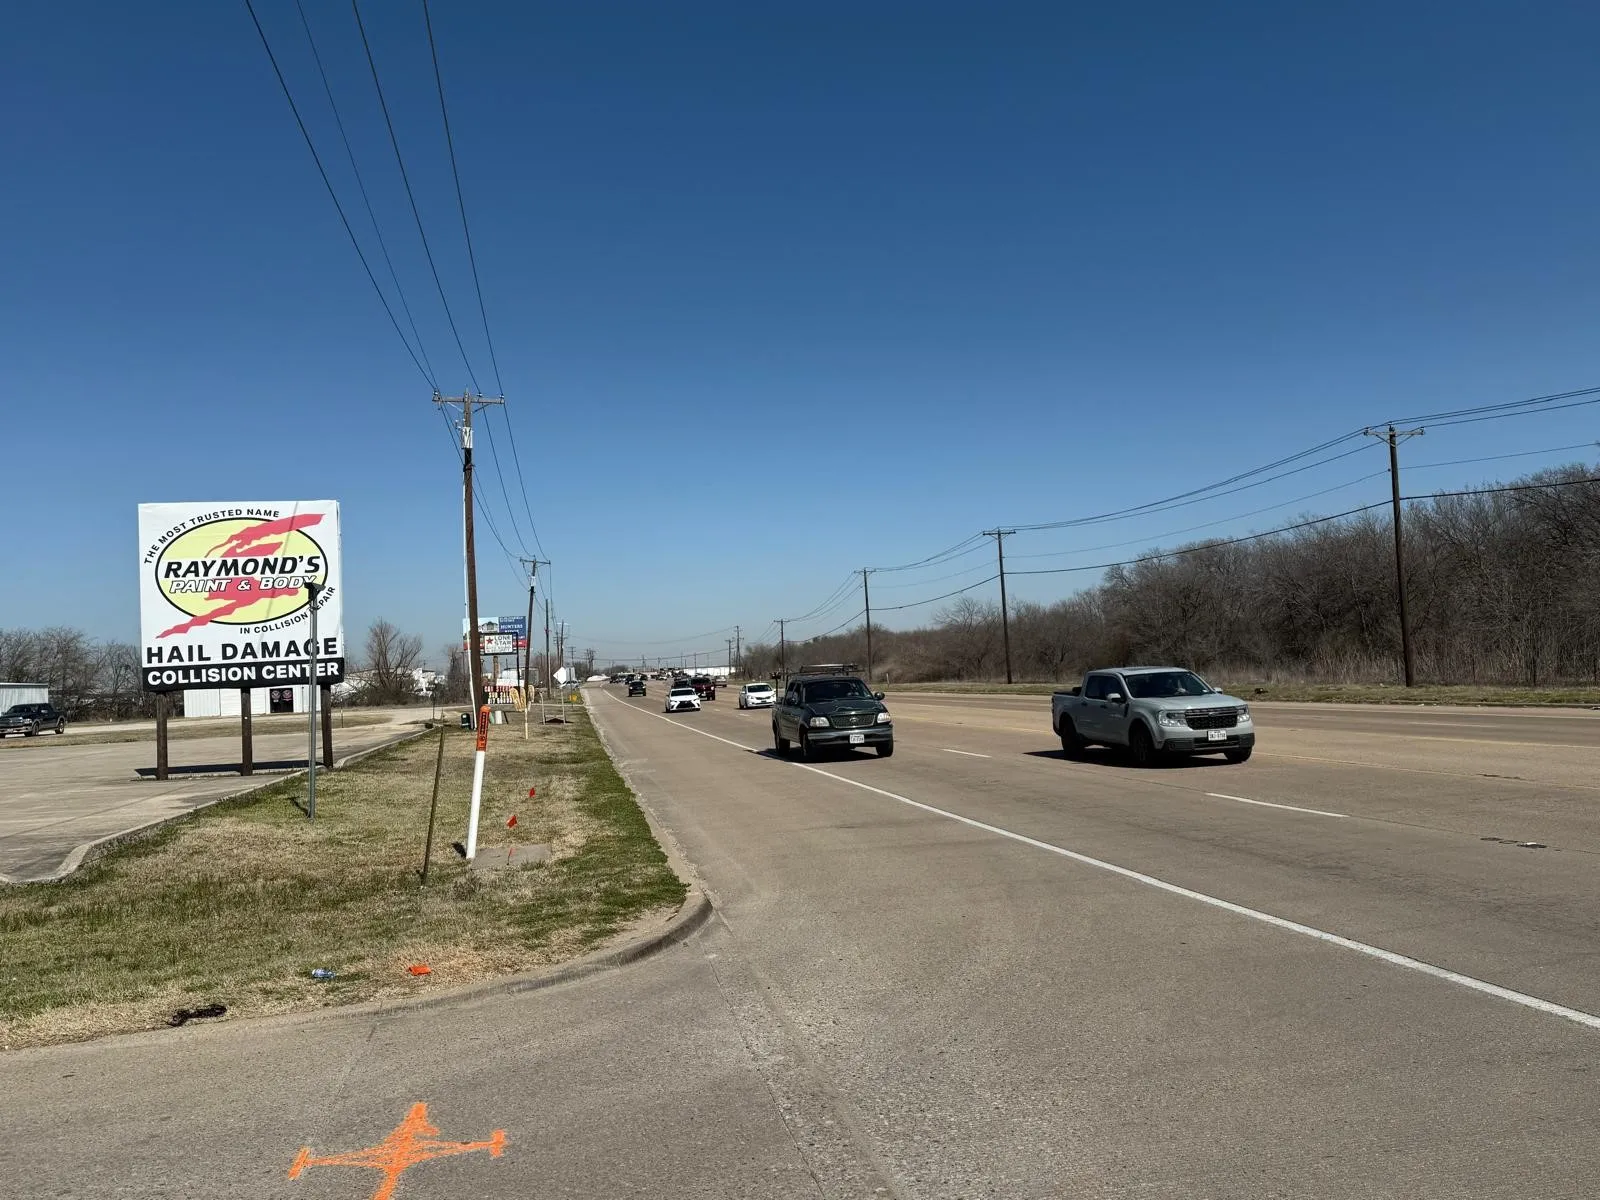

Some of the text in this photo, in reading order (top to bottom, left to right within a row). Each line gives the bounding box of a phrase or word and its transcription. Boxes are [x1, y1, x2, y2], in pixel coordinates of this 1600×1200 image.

[144, 509, 280, 564] THE MOST TRUSTED NAME
[164, 556, 320, 578] RAYMOND'S
[169, 579, 232, 593] PAINT
[237, 580, 251, 591] &
[254, 613, 308, 634] COLLISION
[309, 586, 336, 615] EPAIR
[147, 637, 337, 664] HAIL DAMAGE
[147, 662, 339, 685] COLLISION CENTER
